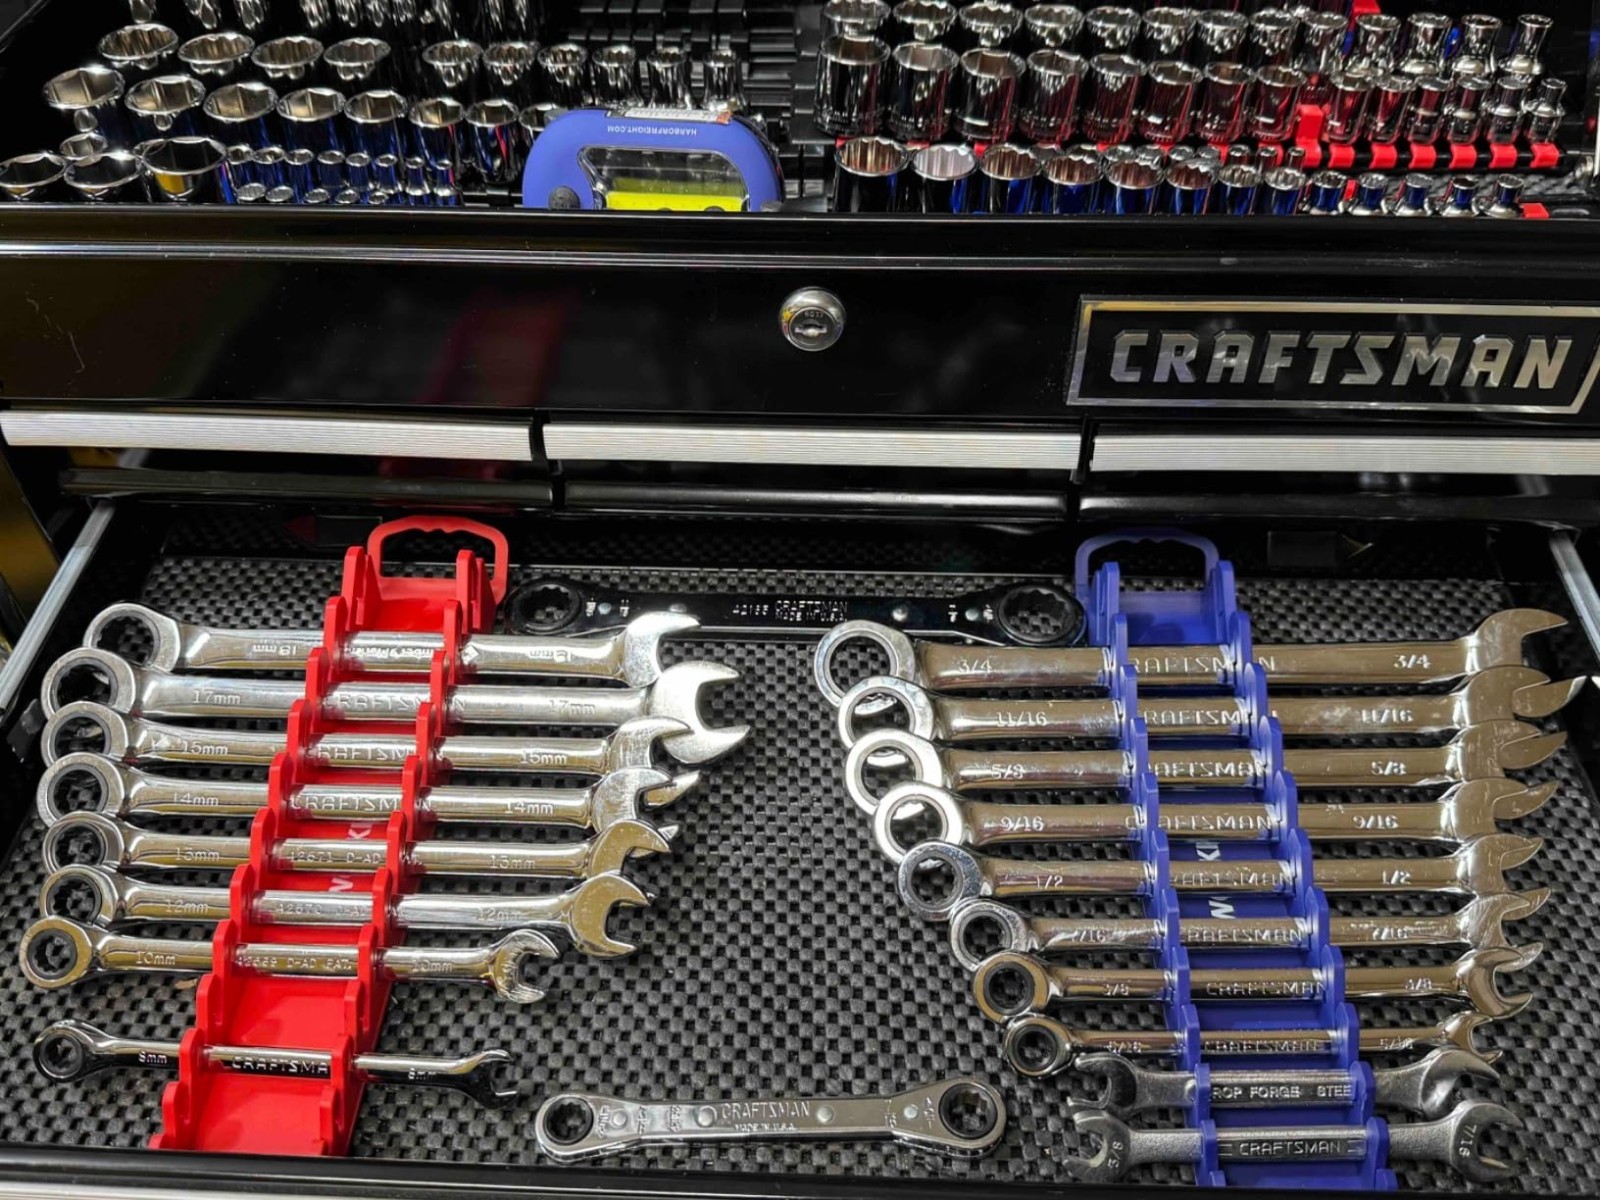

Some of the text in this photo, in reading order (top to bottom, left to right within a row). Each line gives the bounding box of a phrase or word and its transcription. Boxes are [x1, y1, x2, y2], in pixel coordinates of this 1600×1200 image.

[606, 125, 698, 137] HARBORFREIGHT.COM
[1109, 329, 1574, 390] CRAFTSMAN
[775, 600, 848, 613] CRAFTSMAN
[958, 658, 992, 674] 3/4
[1129, 656, 1276, 674] RAFTSMN
[1394, 654, 1431, 669] 3/4
[193, 690, 241, 704] 17mm
[322, 694, 465, 711] CRAFTSN
[549, 700, 596, 715] 17mm
[997, 712, 1047, 727] 11/16
[1361, 709, 1414, 723] 11/16
[173, 793, 219, 806] 14mm
[289, 794, 433, 811] CRAFTSMN
[503, 801, 553, 815] 14mm
[1001, 816, 1045, 832] 9/16
[1125, 815, 1273, 831] CAFTSMAN
[1353, 815, 1399, 829] 9/16
[1036, 875, 1064, 889] 1/2
[1180, 927, 1302, 943] RAFTSMAN
[1206, 981, 1326, 997] CRAFTSMAN
[231, 1055, 329, 1076] CRAFTSMA
[1211, 1085, 1243, 1100] ROP
[1316, 1084, 1353, 1098] STEE
[721, 1101, 810, 1120] CRAFTSMAN
[1239, 1141, 1341, 1157] CRAFTSMAN
